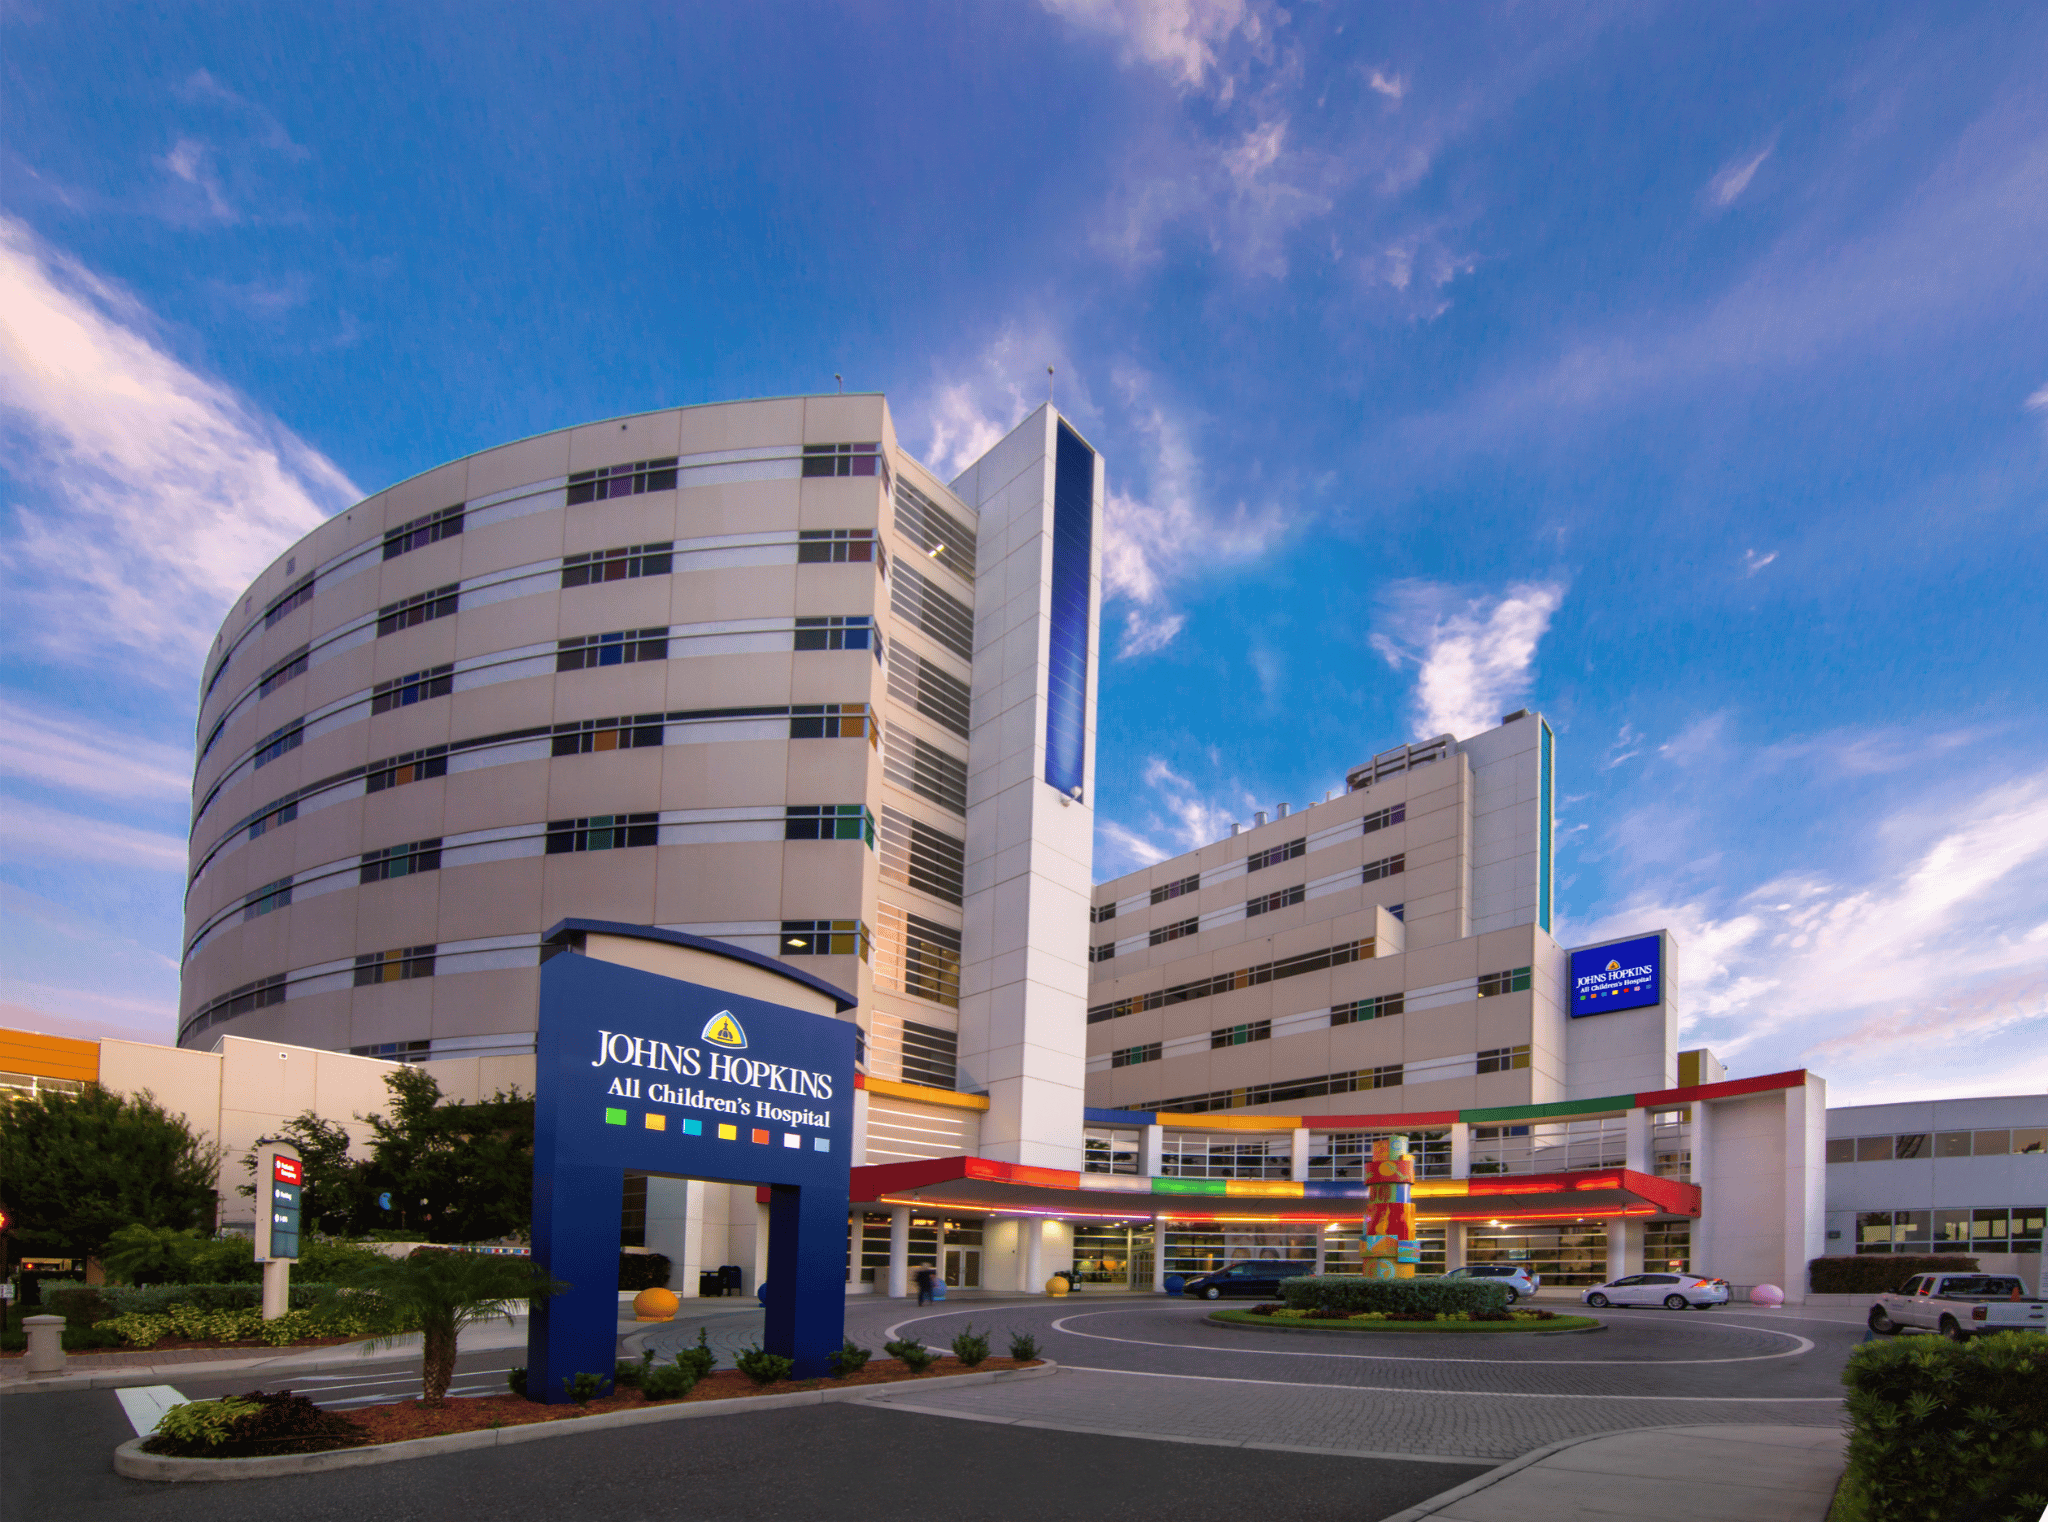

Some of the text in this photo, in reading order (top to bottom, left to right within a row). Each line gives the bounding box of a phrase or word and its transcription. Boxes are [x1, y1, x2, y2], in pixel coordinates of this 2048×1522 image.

[1576, 965, 1652, 988] JOHNS HOPKINS
[1591, 981, 1622, 991] Children's
[1624, 975, 1651, 985] Hospital
[592, 1030, 833, 1100] JOHNS HOPKINS
[607, 1077, 831, 1128] All Children's Hospital
